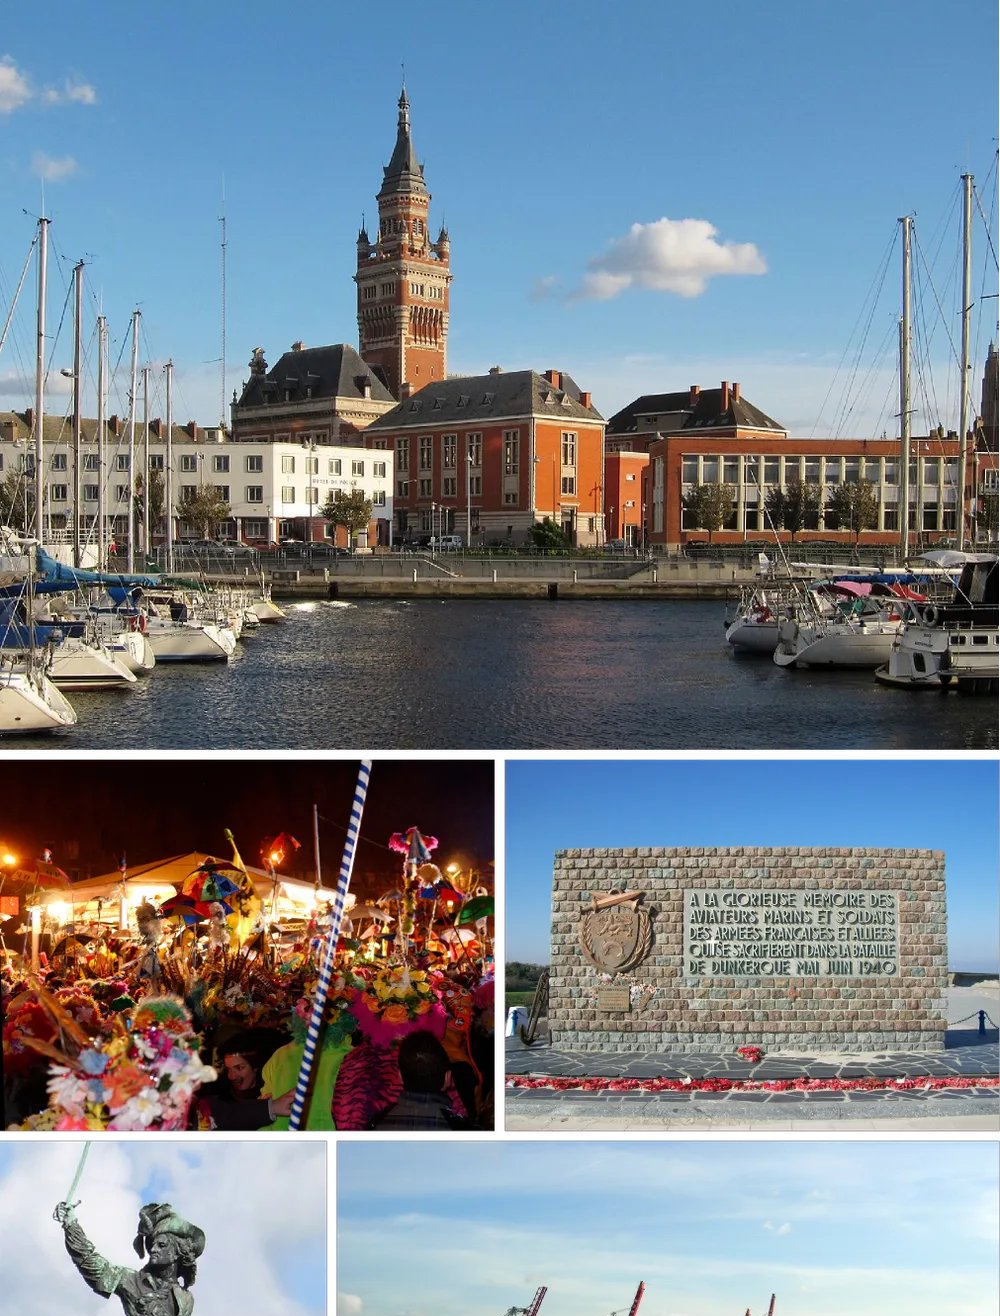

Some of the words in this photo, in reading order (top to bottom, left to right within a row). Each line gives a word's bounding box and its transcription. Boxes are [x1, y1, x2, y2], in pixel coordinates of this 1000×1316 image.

[690, 893, 699, 907] A
[704, 893, 718, 907] LA
[722, 893, 797, 907] GLORIEUSE
[803, 893, 865, 907] MEMOIRE
[870, 893, 895, 907] DES
[690, 910, 759, 924] AVIATEURS
[763, 910, 812, 924] MARINS
[817, 910, 832, 924] ET
[837, 910, 895, 924] SOLDATS
[690, 927, 712, 940] DES
[715, 927, 763, 940] ARMEES
[838, 927, 851, 941] ET
[853, 927, 896, 941] ALLIEES
[690, 944, 714, 958] QUI
[716, 944, 732, 958] SE
[733, 944, 806, 958] SACRIFIERENT
[807, 944, 837, 958] DANS
[839, 944, 851, 958] LA
[853, 944, 896, 958] BATAILLE
[690, 960, 706, 975] DE
[711, 960, 791, 975] DUNKERQUE
[796, 960, 819, 975] MAI
[824, 960, 853, 975] JUIN
[858, 960, 897, 975] 1940
